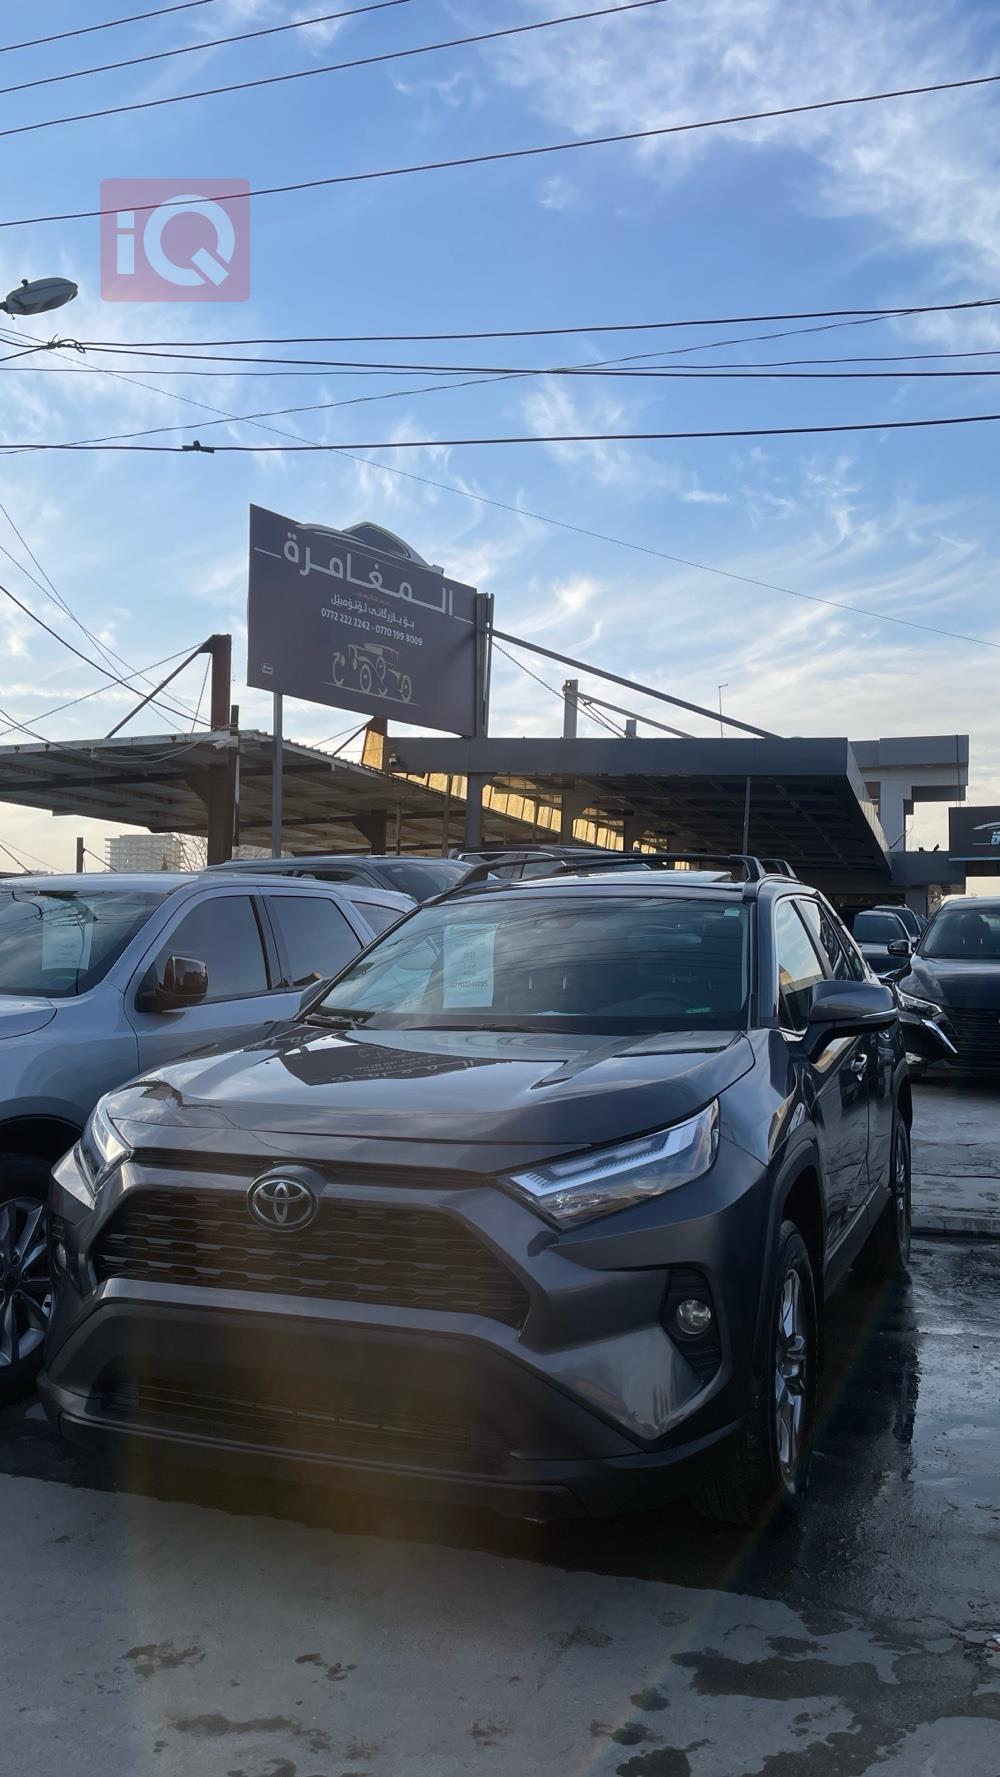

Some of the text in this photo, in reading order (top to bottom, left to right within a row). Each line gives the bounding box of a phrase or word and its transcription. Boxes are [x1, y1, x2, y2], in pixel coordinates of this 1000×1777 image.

[283, 532, 453, 616] المغامرة
[321, 607, 339, 622] 0772
[339, 613, 353, 625] 222
[354, 617, 370, 631] 2242
[375, 624, 392, 637] 0770
[392, 629, 405, 641] 199
[405, 633, 423, 646] 8009
